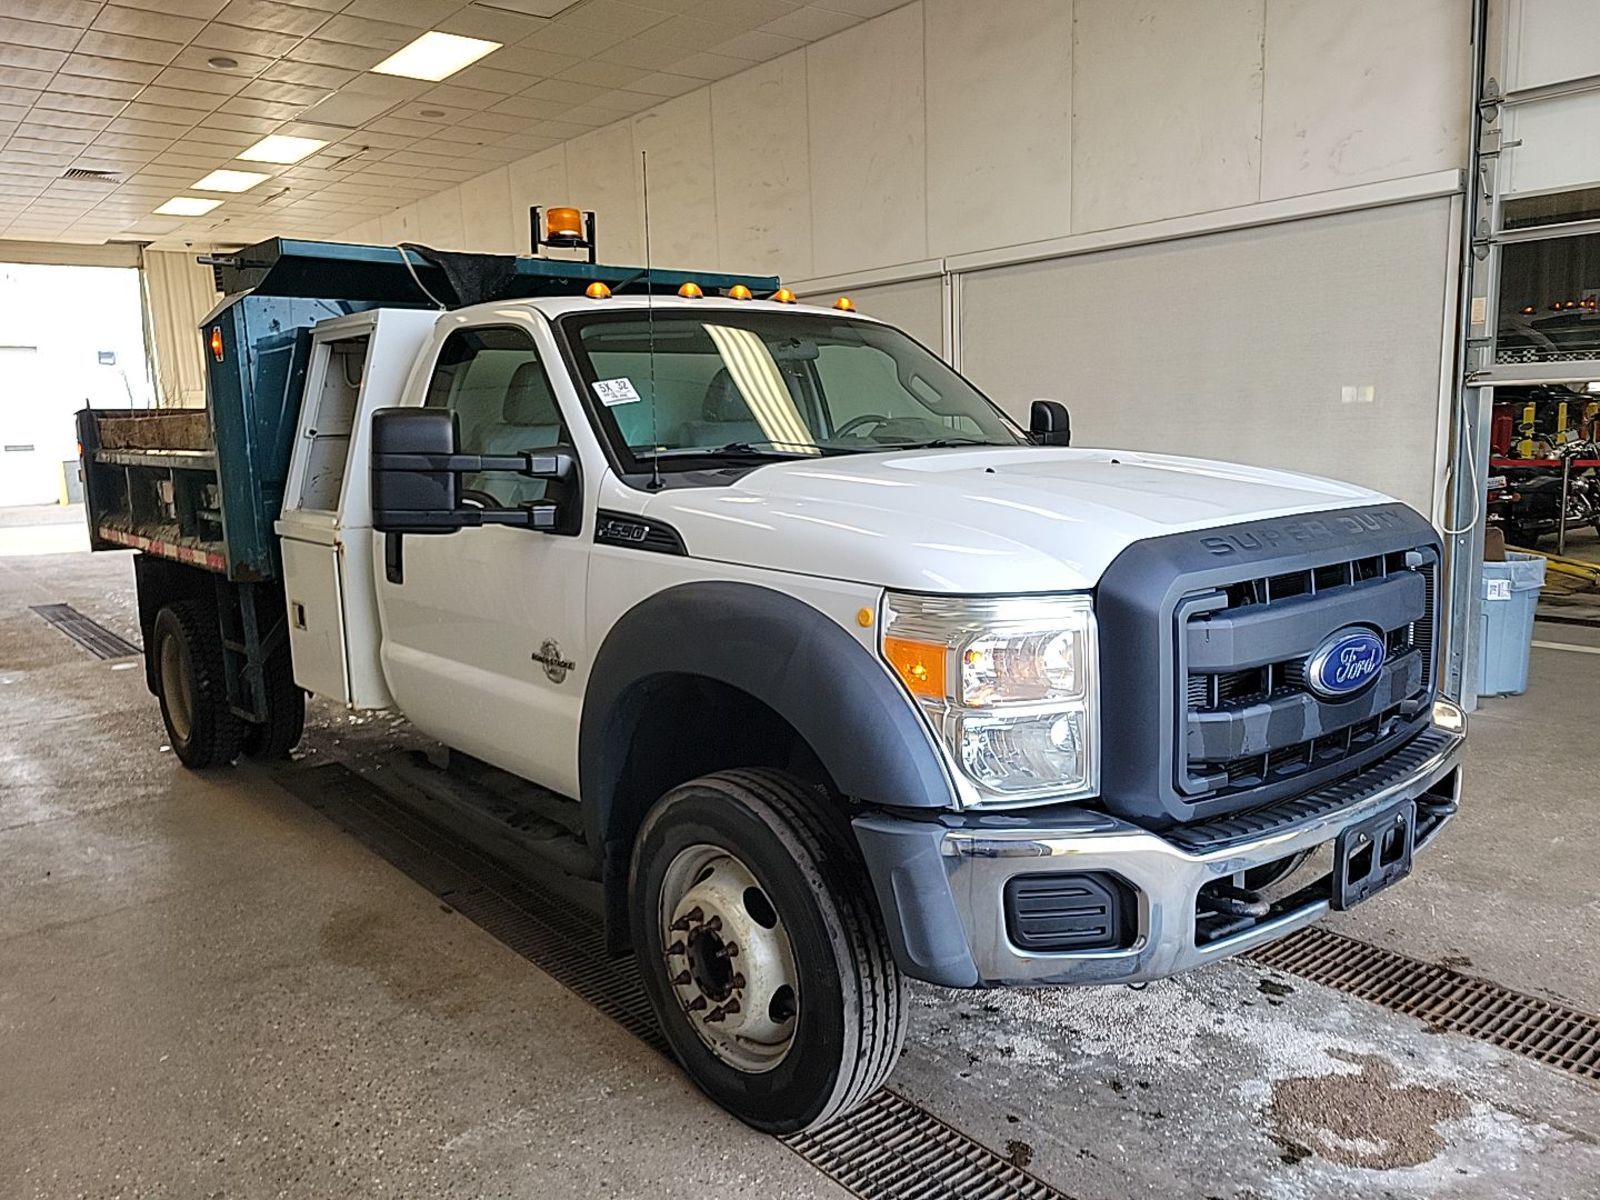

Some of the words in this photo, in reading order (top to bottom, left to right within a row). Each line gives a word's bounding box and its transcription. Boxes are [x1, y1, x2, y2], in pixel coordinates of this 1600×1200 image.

[1200, 522, 1331, 556] SUPER
[1336, 511, 1400, 534] DUTY
[1336, 644, 1376, 683] Ford
